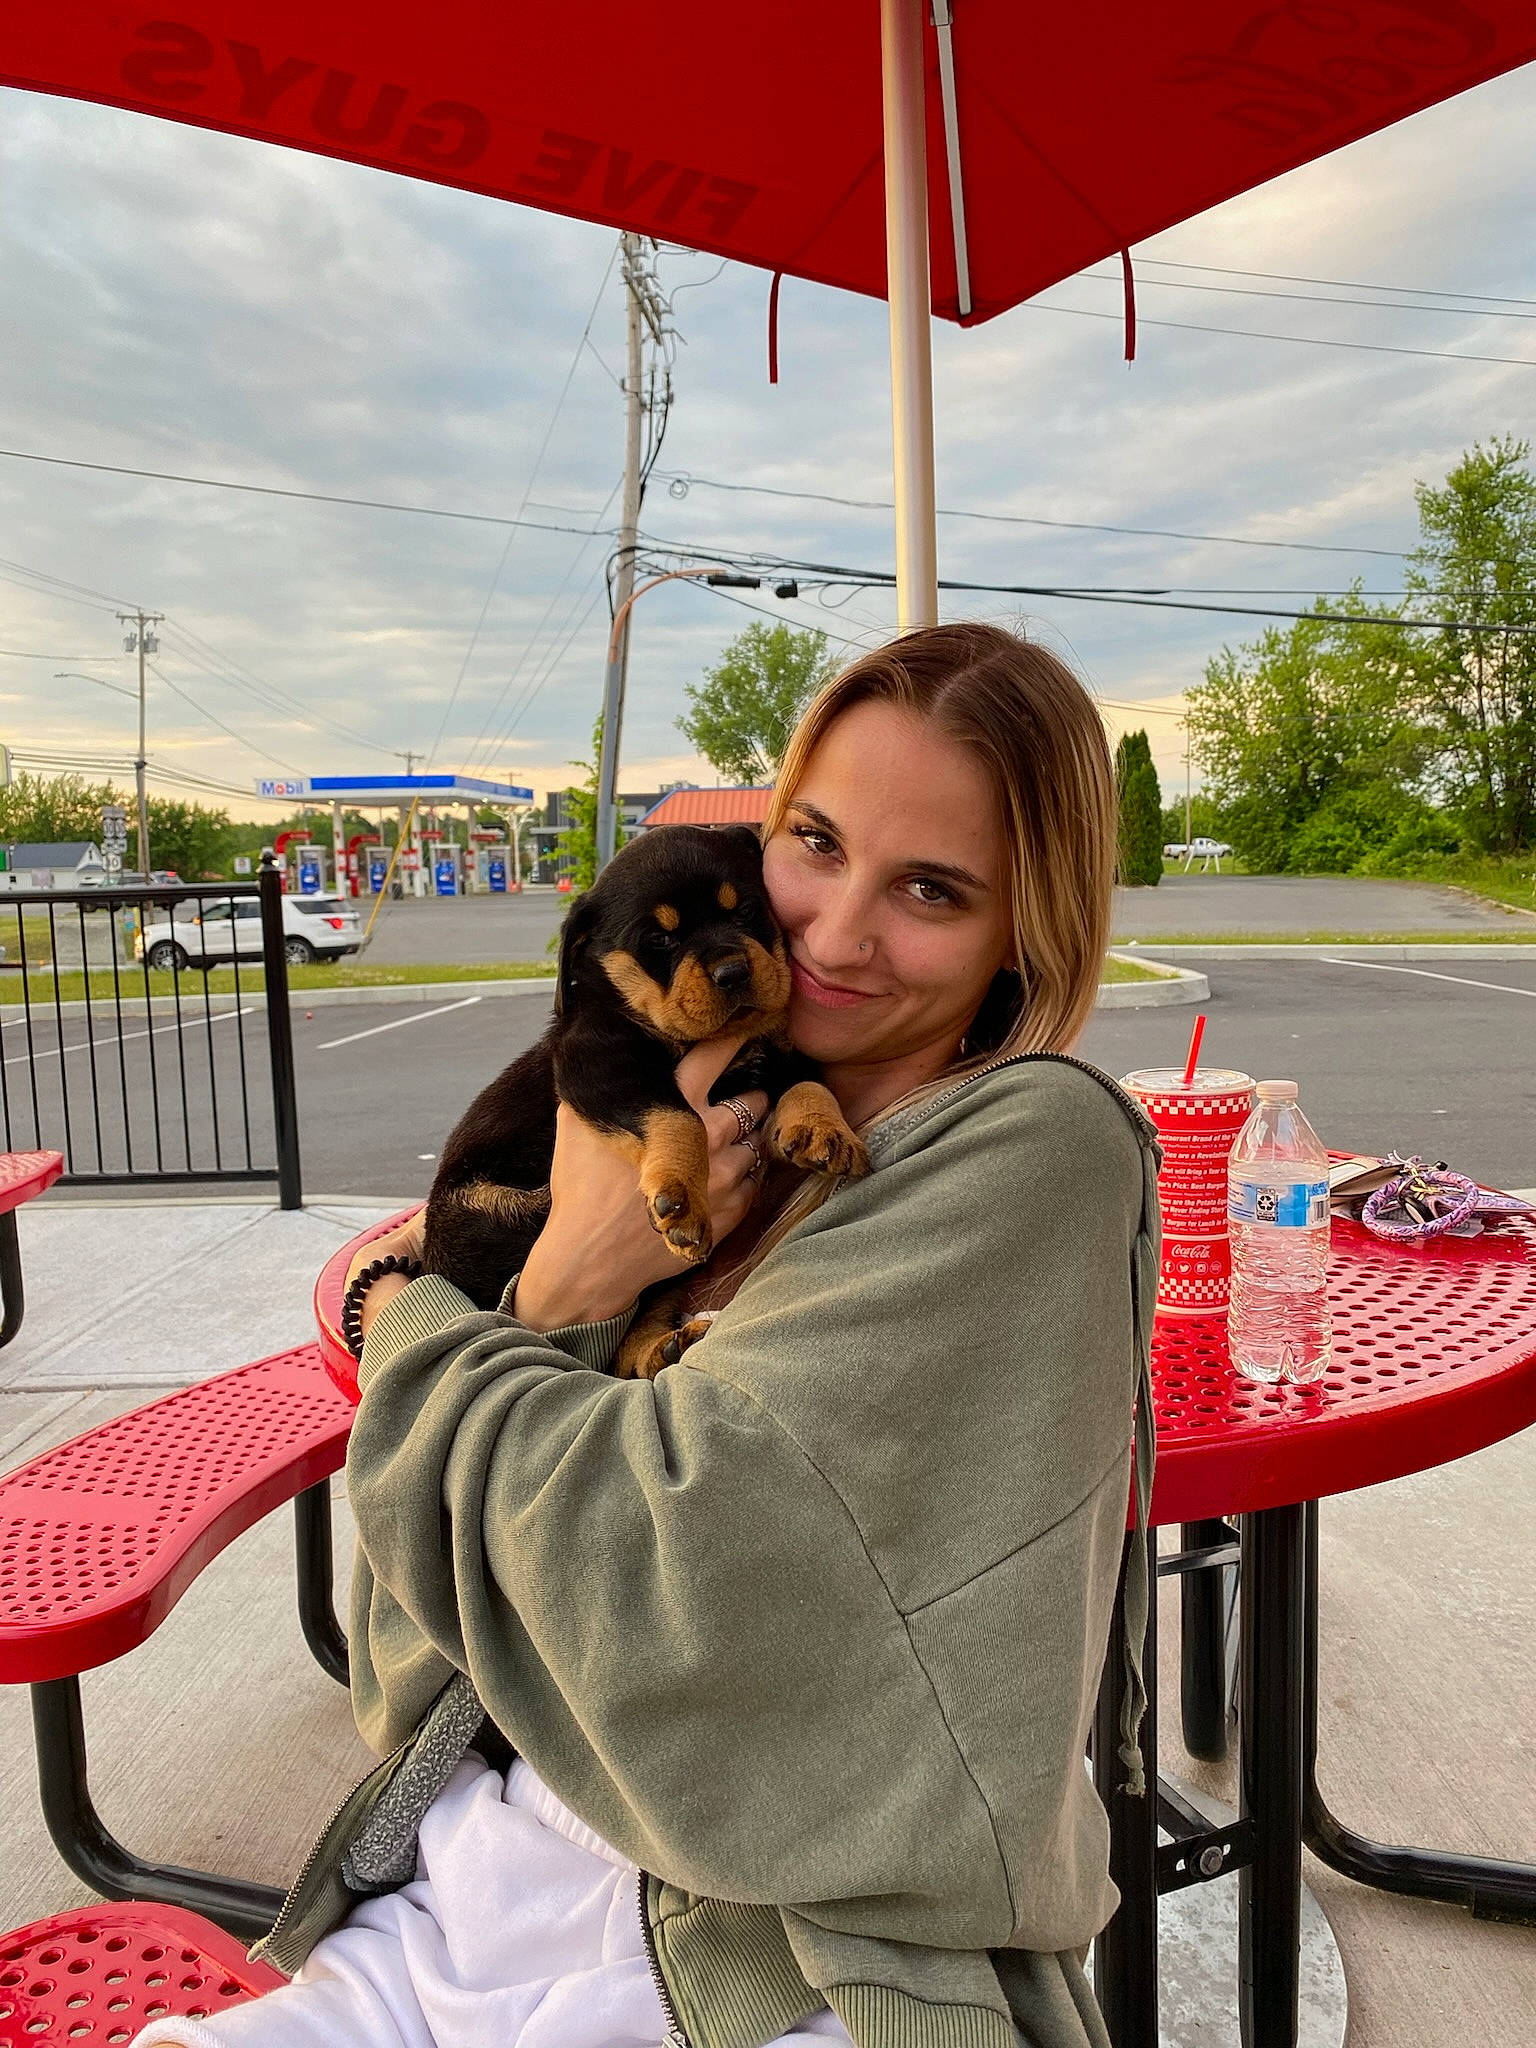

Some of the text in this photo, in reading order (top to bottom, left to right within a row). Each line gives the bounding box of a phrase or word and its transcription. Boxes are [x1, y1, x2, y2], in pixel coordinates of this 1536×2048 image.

[261, 781, 305, 796] Mobil
[1156, 1134, 1191, 1142] estaurant
[1206, 1182, 1226, 1190] Burger
[1166, 1218, 1187, 1227] Burger
